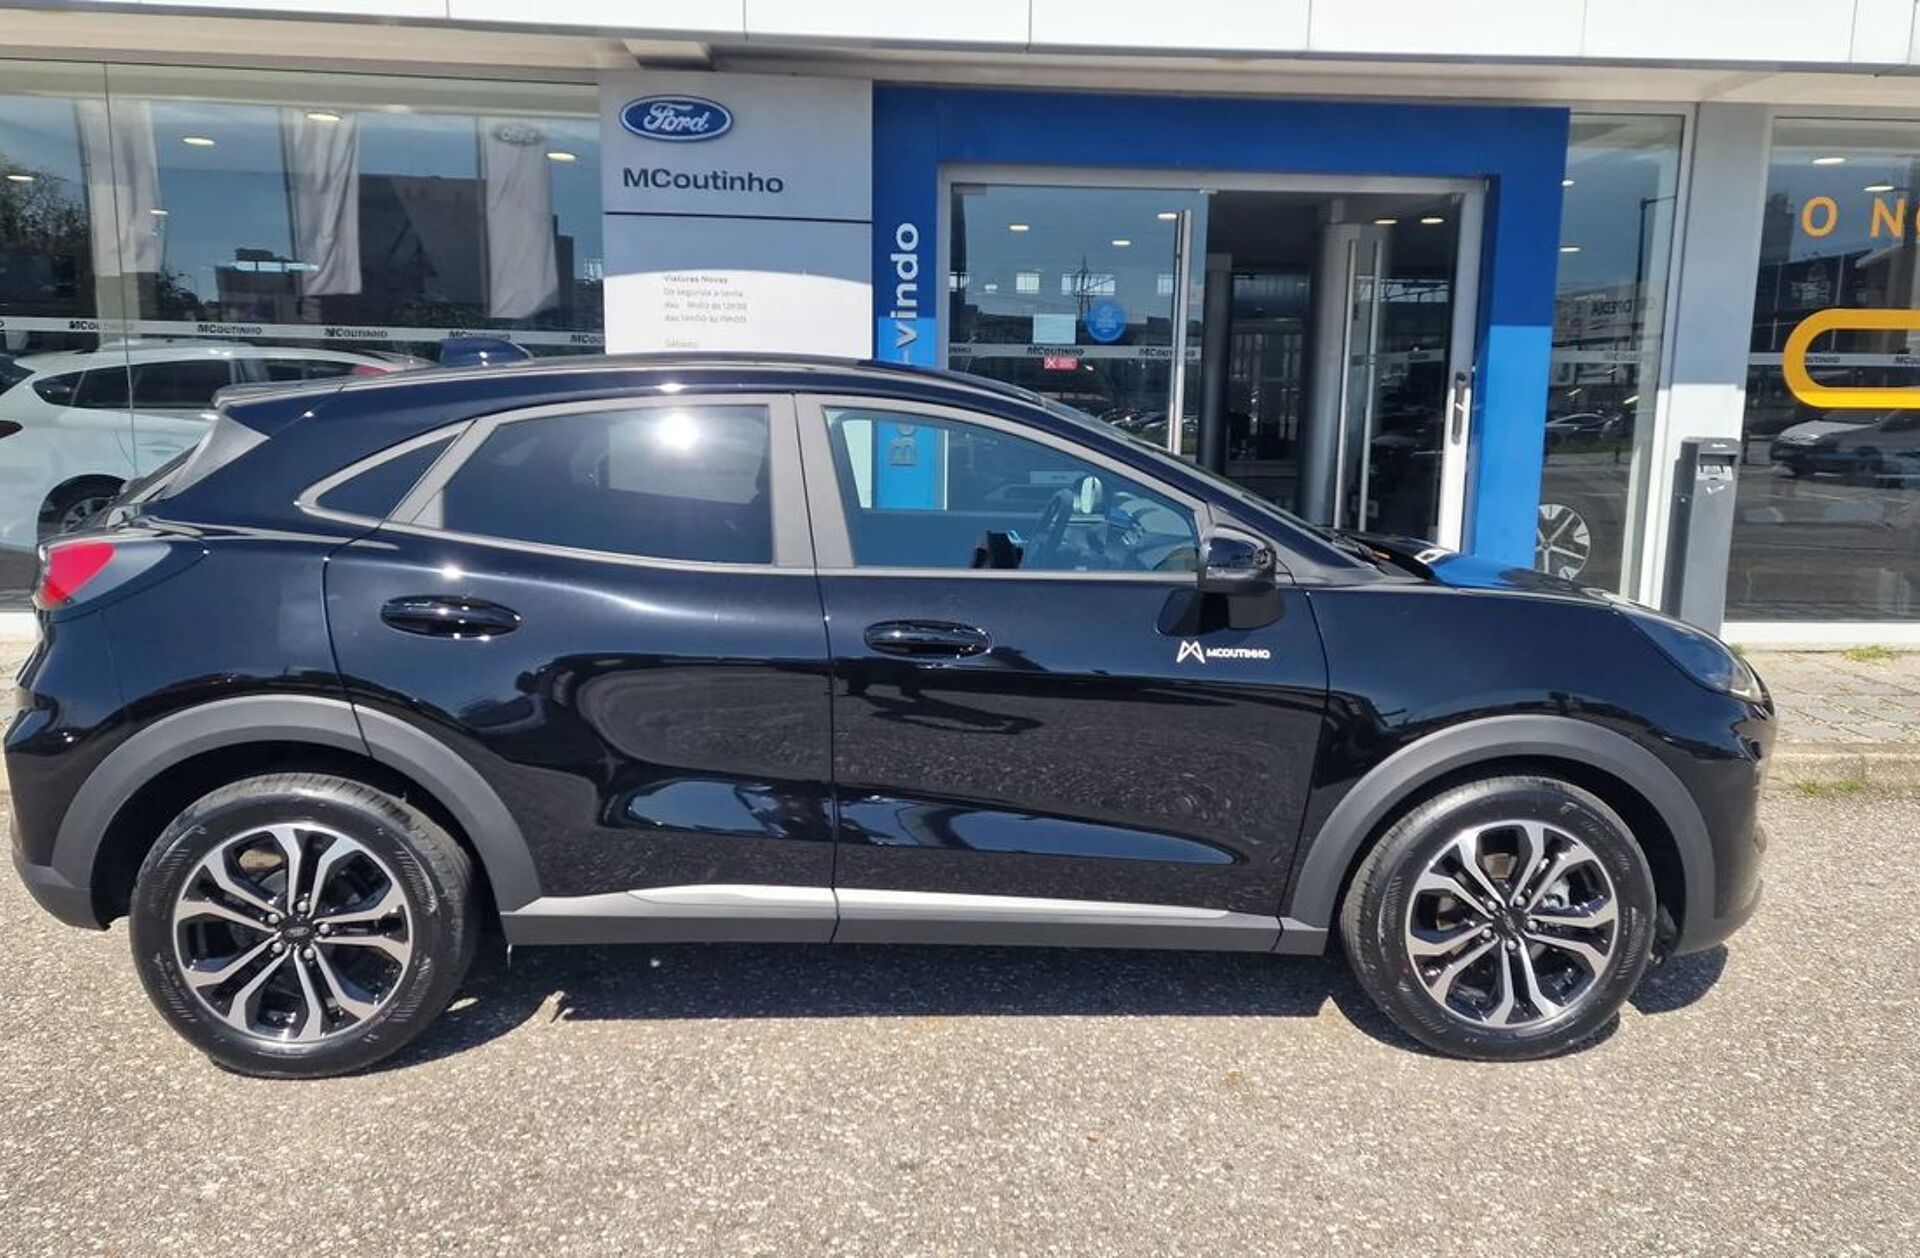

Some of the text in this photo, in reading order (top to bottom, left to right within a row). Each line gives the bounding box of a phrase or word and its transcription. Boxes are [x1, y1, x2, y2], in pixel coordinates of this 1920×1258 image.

[623, 167, 784, 194] MCoutinho
[1802, 196, 1838, 237] O
[1206, 648, 1271, 659] MCOUTINHO
